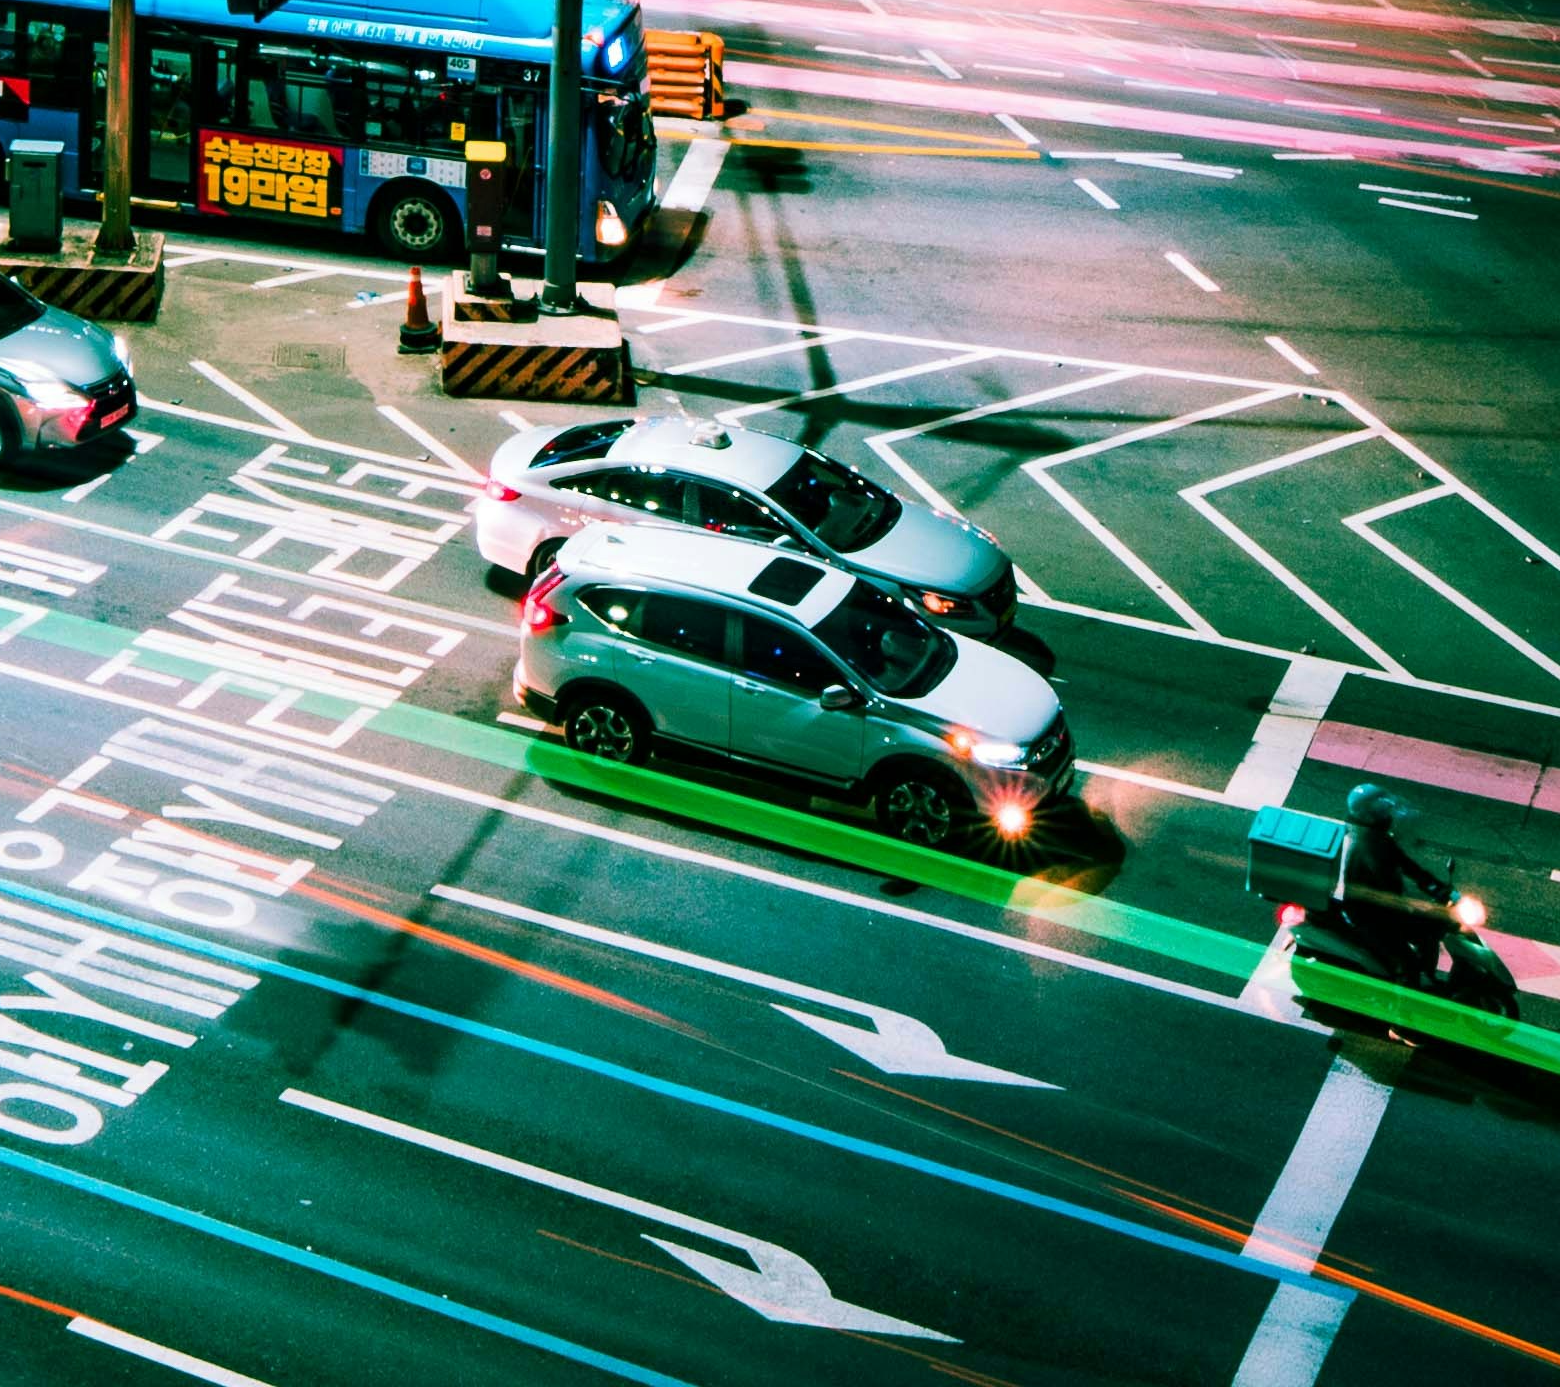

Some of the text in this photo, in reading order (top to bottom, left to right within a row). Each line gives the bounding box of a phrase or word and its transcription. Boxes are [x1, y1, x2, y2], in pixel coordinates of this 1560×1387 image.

[448, 58, 470, 71] 405
[205, 136, 331, 178] 수능전강좌
[206, 162, 328, 218] 19만원
[153, 445, 480, 593] 퇴계로
[86, 573, 468, 749] 퇴계로
